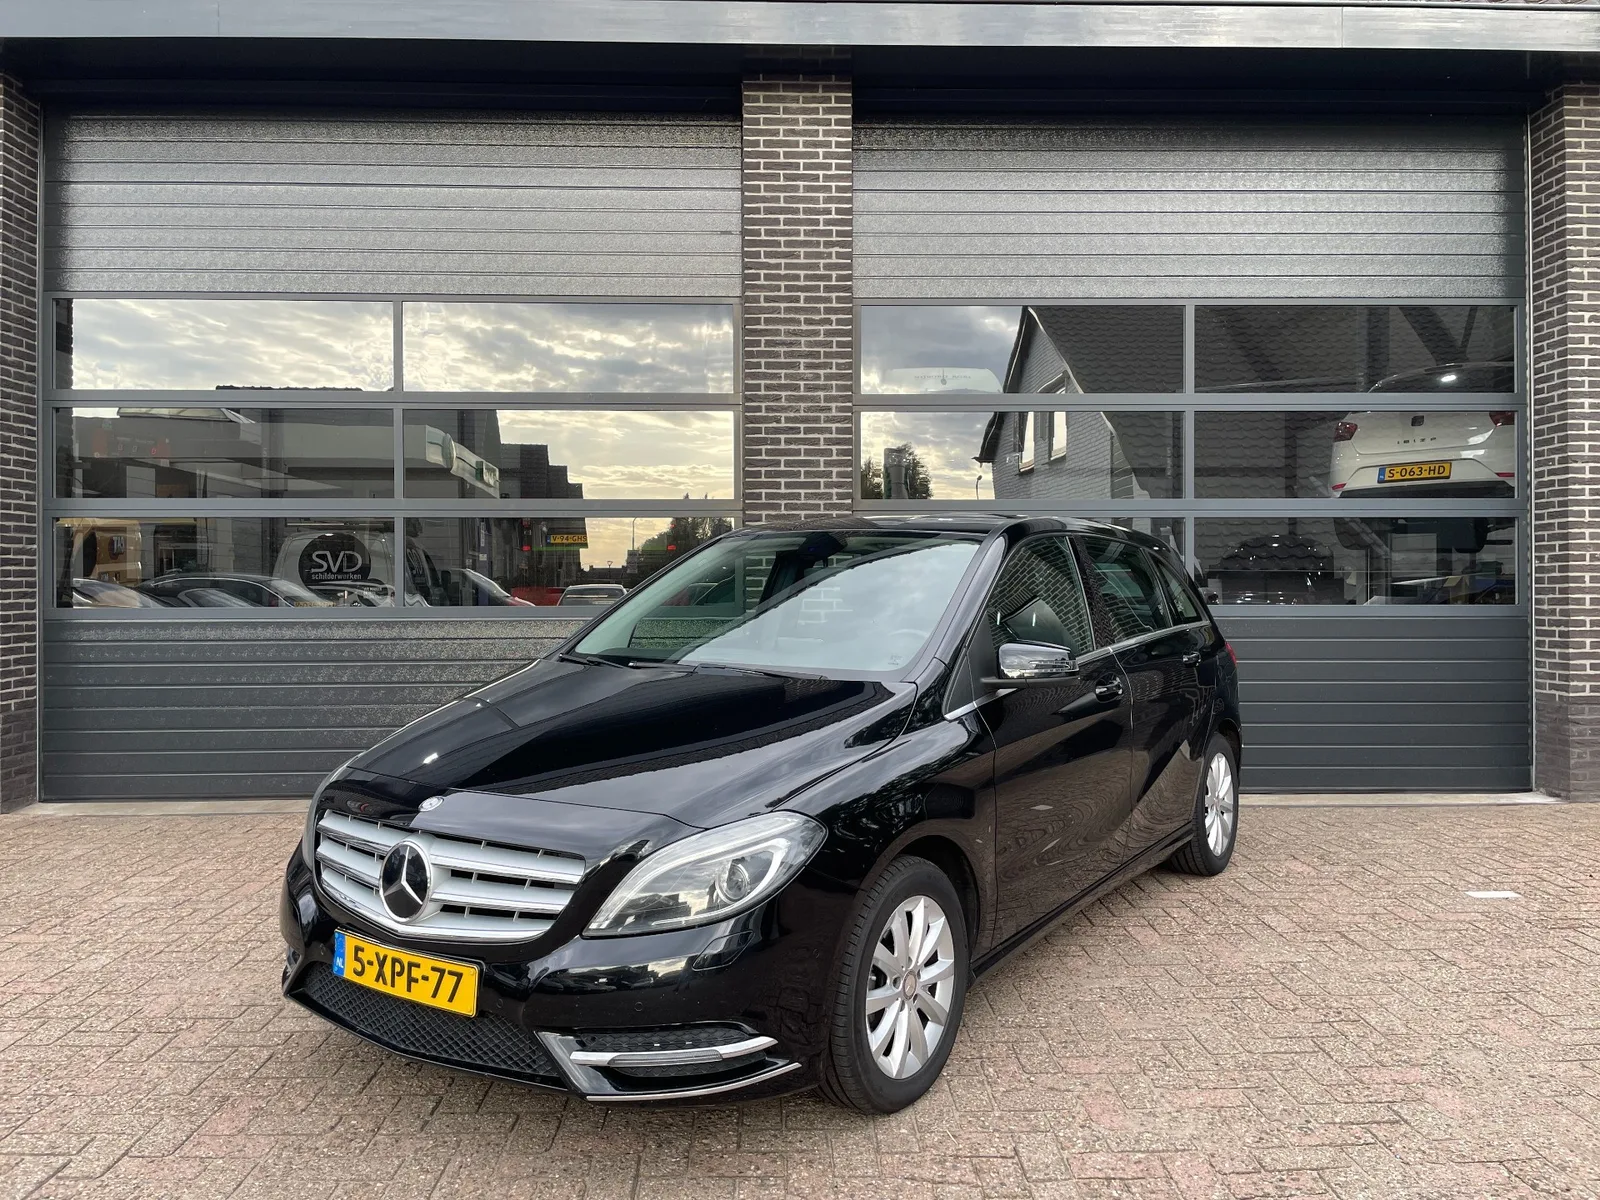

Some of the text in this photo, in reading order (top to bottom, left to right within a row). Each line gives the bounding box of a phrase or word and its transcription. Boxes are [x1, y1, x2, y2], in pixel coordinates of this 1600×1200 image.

[1387, 465, 1446, 479] S-063-HD
[552, 535, 588, 543] V-94-GHS
[308, 550, 363, 573] SVD
[336, 944, 464, 1003] NL 5-XPF-77
